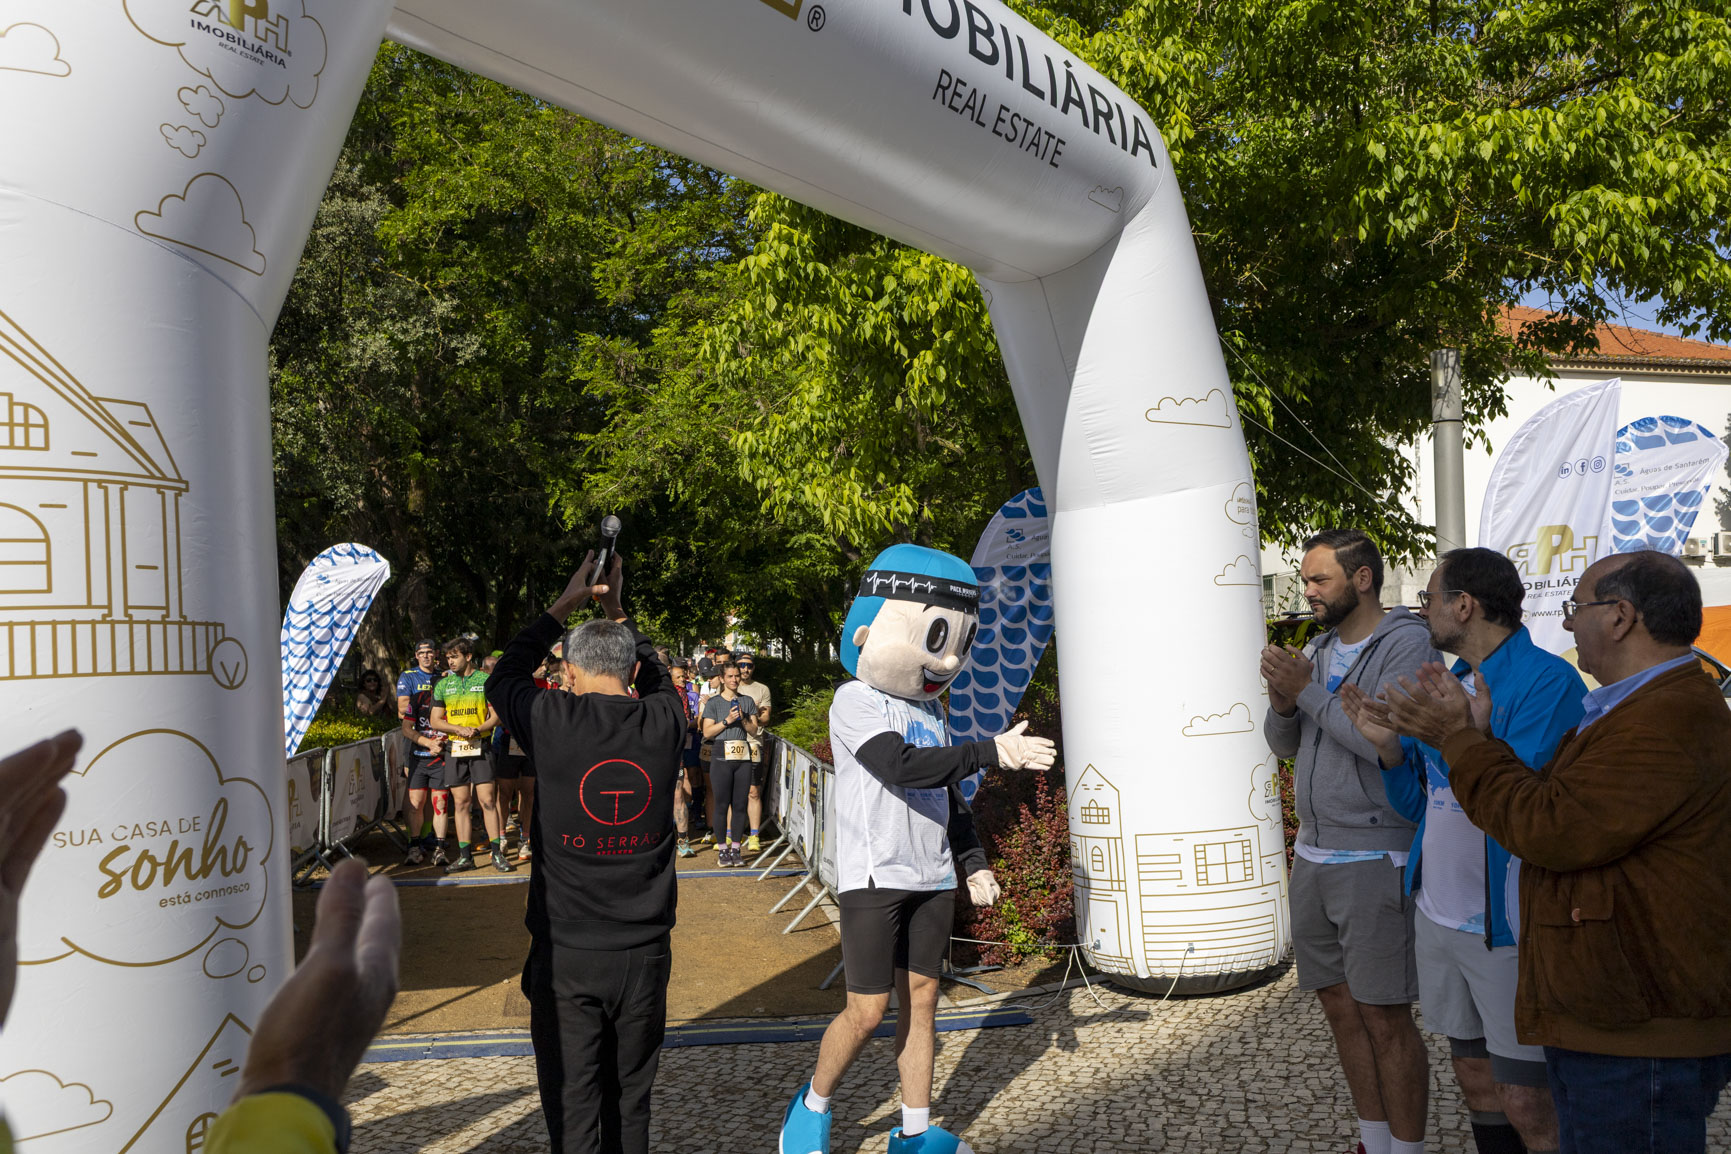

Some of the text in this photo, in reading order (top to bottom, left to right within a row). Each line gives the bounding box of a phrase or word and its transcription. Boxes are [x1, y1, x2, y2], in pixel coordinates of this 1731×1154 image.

[191, 19, 287, 69] IMOBILIÁRIA
[218, 41, 265, 67] REAL ESTATE
[902, 0, 1158, 169] OBILIÁRIA
[932, 69, 1066, 169] REAL ESTATE
[1639, 457, 1710, 475] Águas de Santarém
[730, 745, 745, 754] 207
[53, 815, 202, 849] SUA CASA DE
[561, 833, 585, 849] TÓ
[97, 797, 254, 899] sonho
[159, 882, 250, 908] está connosco
